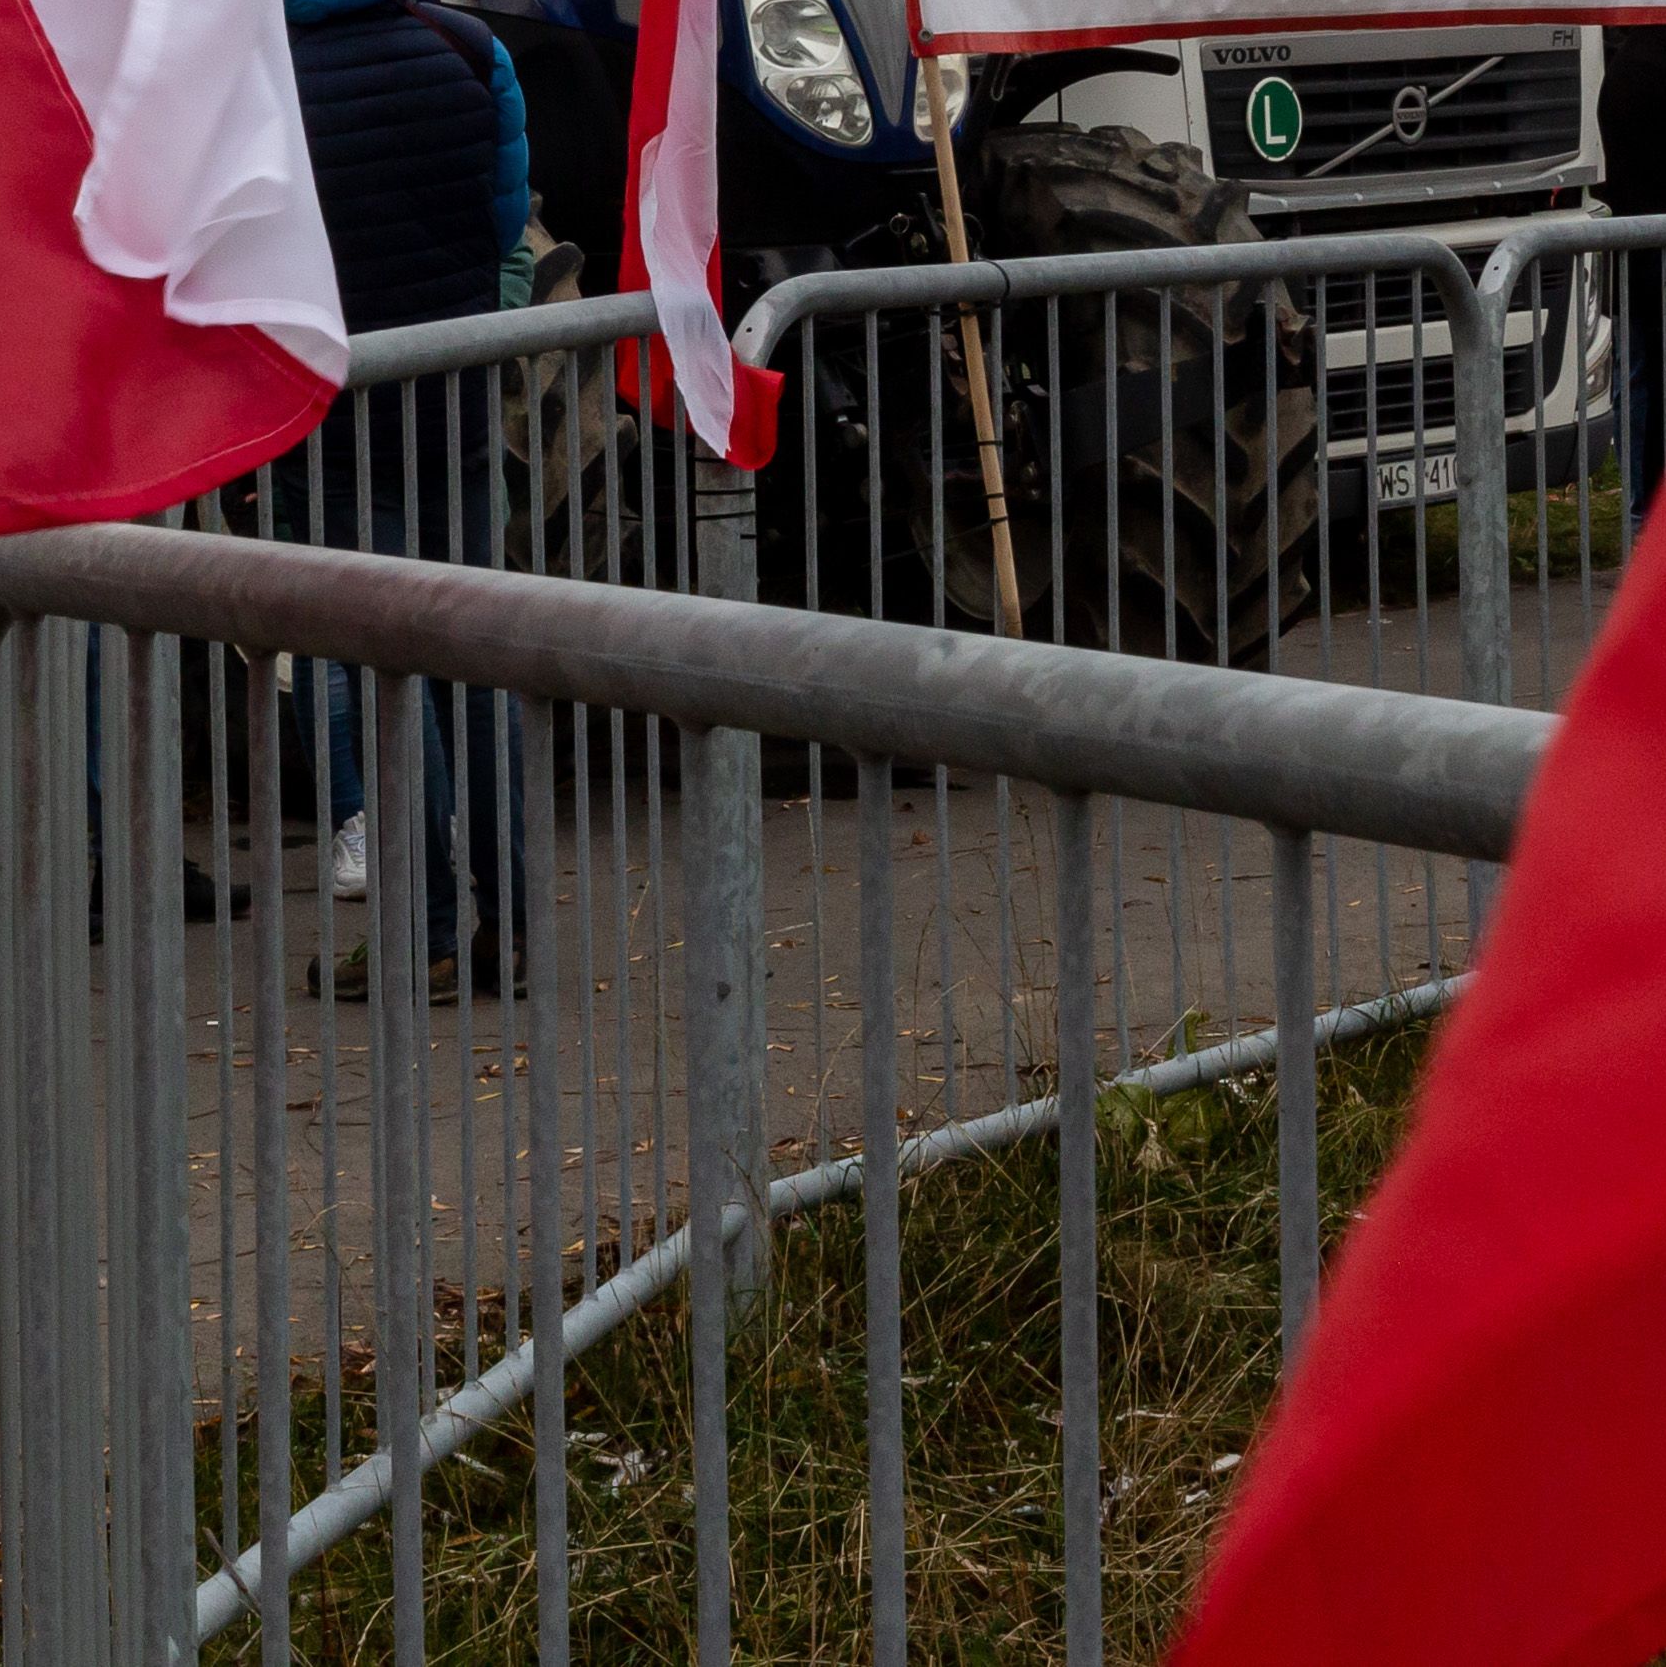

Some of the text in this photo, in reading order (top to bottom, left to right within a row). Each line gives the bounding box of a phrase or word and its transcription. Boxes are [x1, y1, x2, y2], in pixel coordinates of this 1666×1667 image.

[1552, 29, 1574, 46] FH
[1212, 44, 1292, 65] VOLVO
[1264, 94, 1287, 145] L
